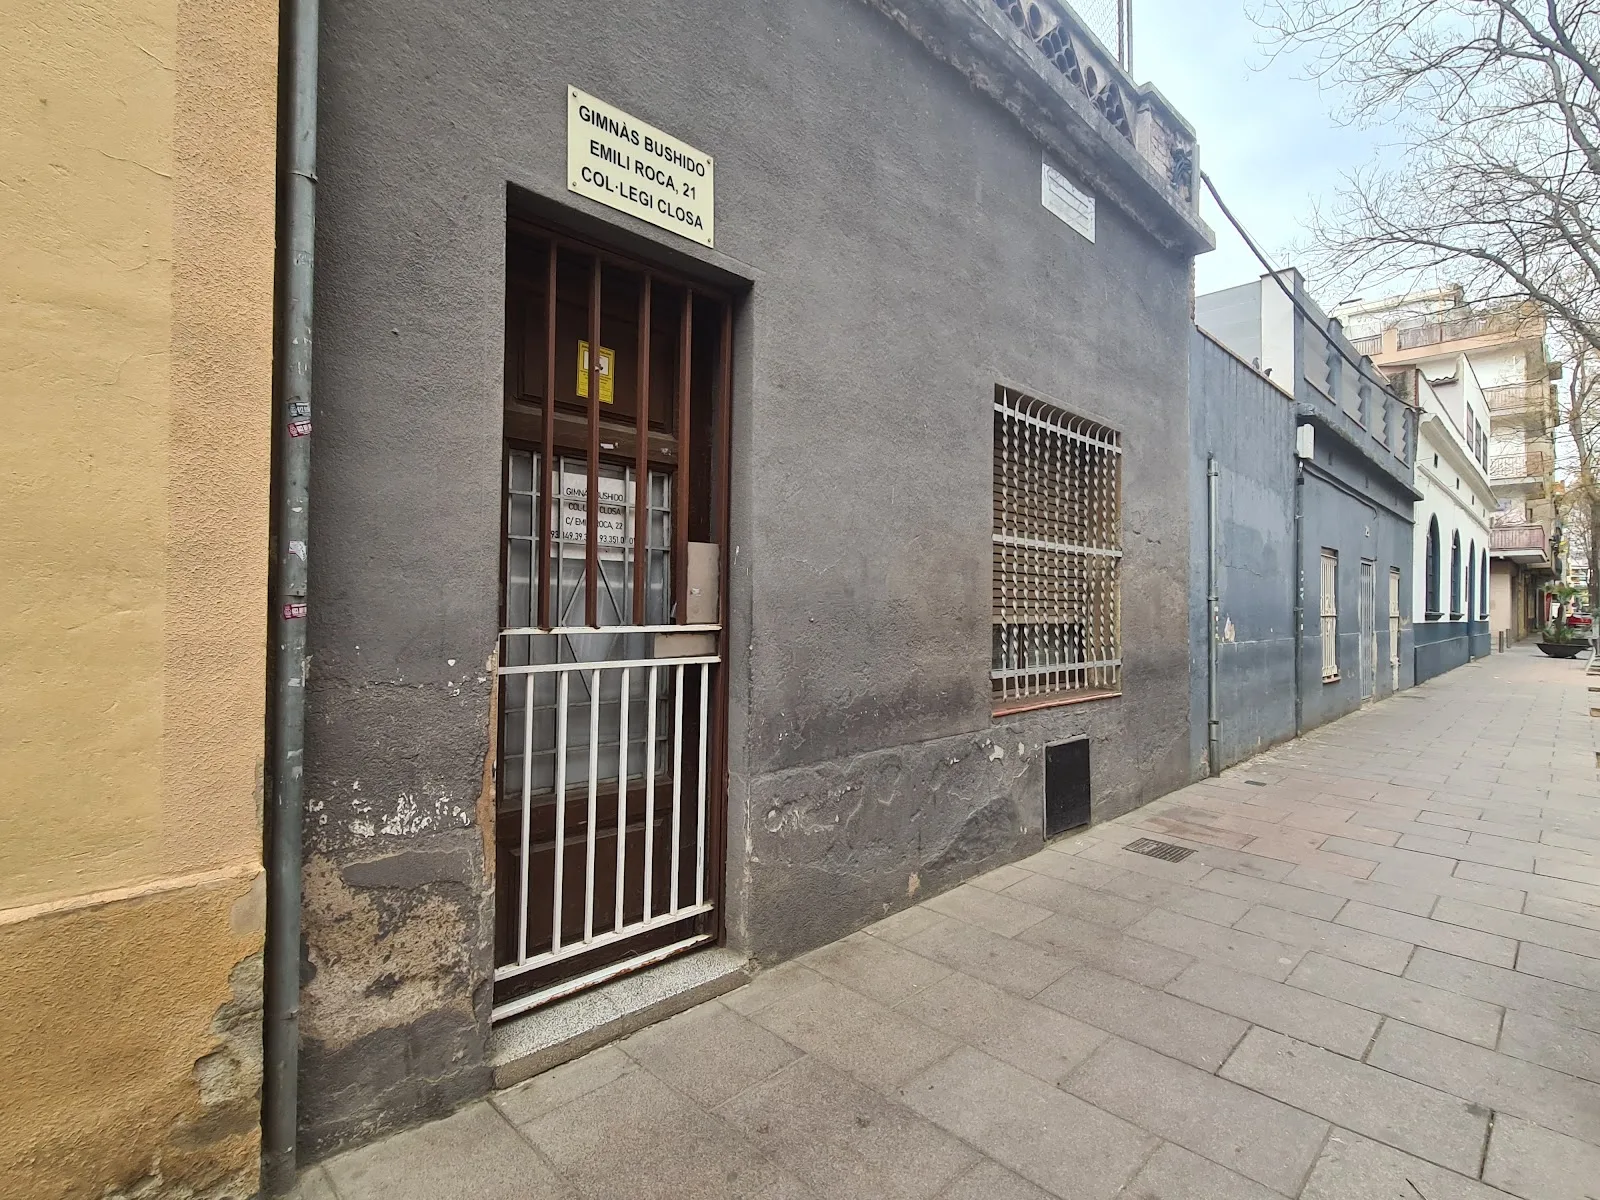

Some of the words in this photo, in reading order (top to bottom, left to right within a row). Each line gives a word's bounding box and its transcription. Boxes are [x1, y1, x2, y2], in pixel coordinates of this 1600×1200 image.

[579, 105, 640, 146] GIMNÀS
[644, 135, 705, 177] BUSHIDO
[590, 139, 630, 170] EMILI
[635, 160, 679, 194] ROCA,
[682, 182, 696, 200] 21
[581, 166, 653, 209] COL·LEGI
[657, 198, 704, 230] CLOSA
[565, 516, 574, 526] C/
[597, 520, 613, 530] OCA,
[615, 521, 623, 529] 22
[566, 487, 587, 497] GIMNÀ
[598, 492, 624, 501] USHIDO
